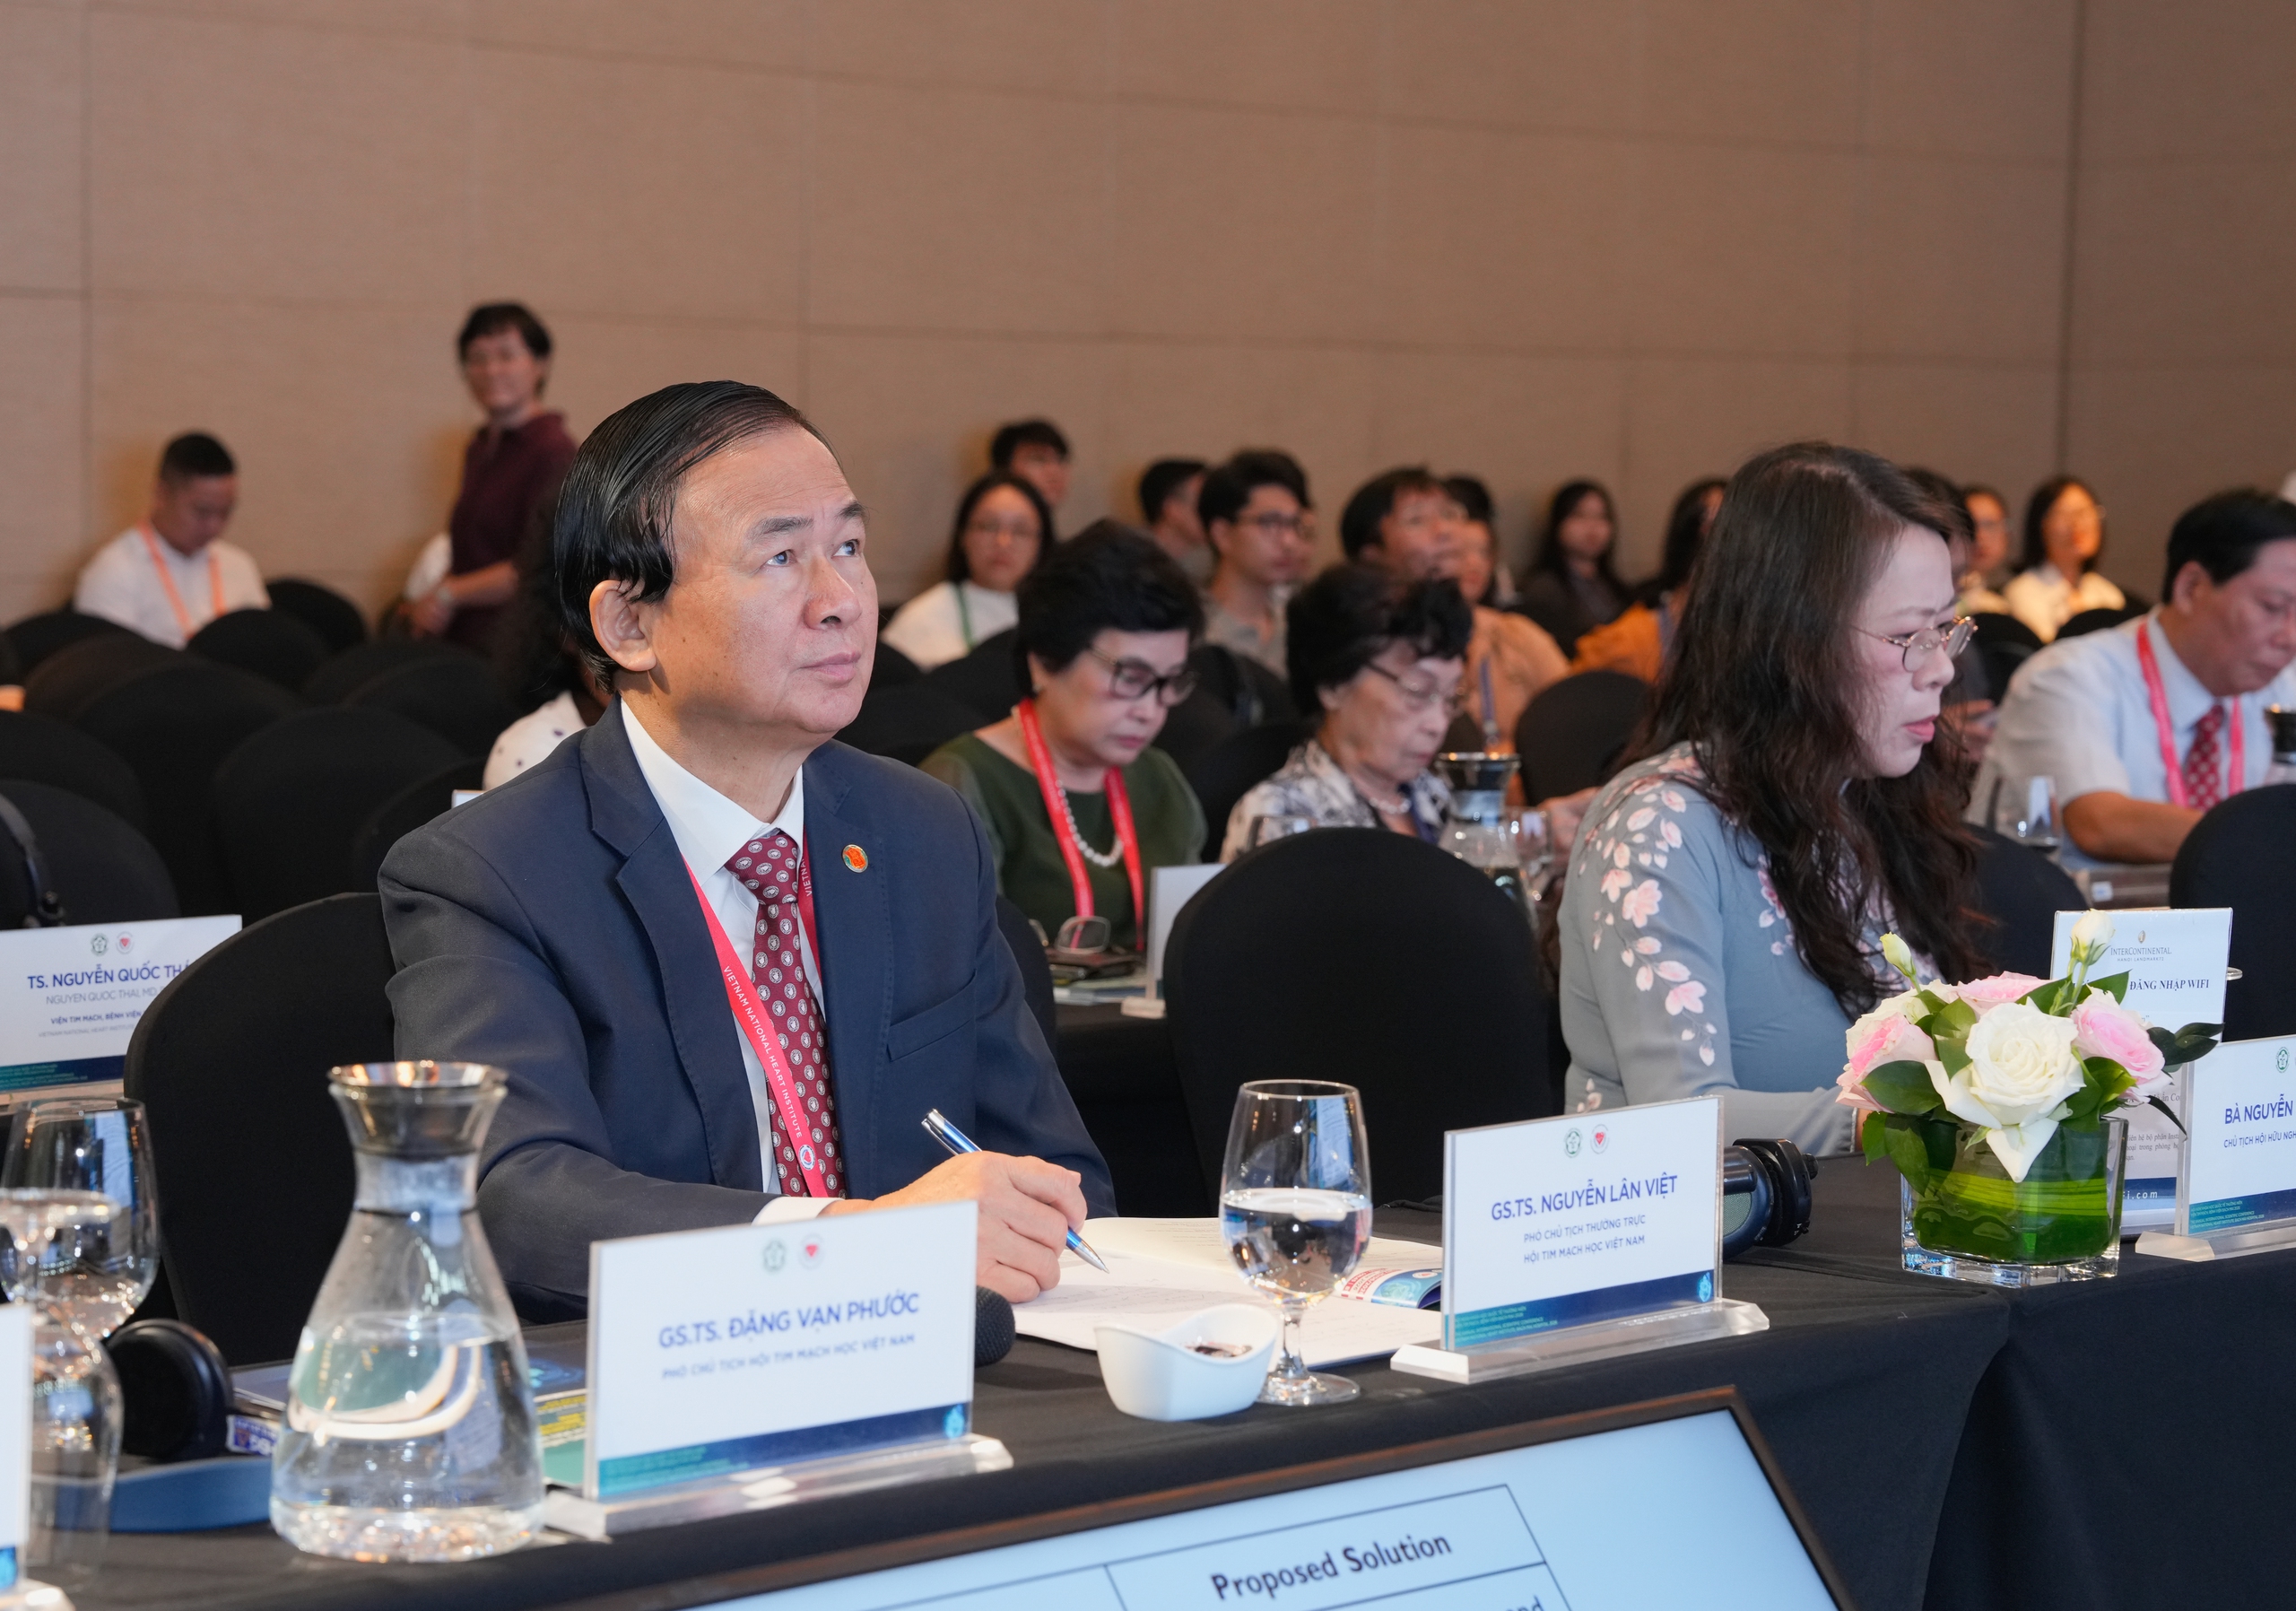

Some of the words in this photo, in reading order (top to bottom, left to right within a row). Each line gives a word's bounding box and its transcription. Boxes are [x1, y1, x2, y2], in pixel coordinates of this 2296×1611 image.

[800, 858, 813, 897] VIETNA
[27, 975, 48, 989] TS.
[52, 963, 114, 988] NGUYỄN
[117, 960, 160, 982] QUỐC
[2129, 979, 2157, 990] ĐĂNG
[2159, 978, 2186, 991] NHẬP
[2187, 979, 2210, 988] WIFI
[69, 1015, 81, 1023] TIM
[723, 965, 750, 1007] VIETNAM
[744, 1006, 772, 1055] NATIONAL
[768, 1055, 787, 1086] HEART
[781, 1088, 803, 1139] INSTITUTE
[2224, 1102, 2241, 1125] BÀ
[2244, 1093, 2293, 1121] NGUYỄN
[2223, 1134, 2238, 1148] CHỦ
[2239, 1136, 2254, 1148] TỊCH
[2255, 1132, 2266, 1145] HỘI
[2267, 1130, 2283, 1143] HỮU
[1491, 1197, 1537, 1221] GS.TS.
[1541, 1178, 1606, 1213] NGUYỄN
[1610, 1177, 1641, 1203] LÂN
[1645, 1171, 1678, 1199] VIỆT
[1524, 1228, 1543, 1243] PHÓ
[1544, 1223, 1563, 1241] CHỦ
[1564, 1223, 1584, 1239] TỊCH
[1623, 1214, 1647, 1230] TRỰC
[1523, 1249, 1540, 1265] HỘI
[1542, 1249, 1557, 1260] TIM
[1558, 1244, 1583, 1259] MẠCH
[1584, 1241, 1604, 1256] HỌC
[1605, 1235, 1624, 1250] VIỆT
[1625, 1234, 1645, 1248] NAM
[658, 1320, 722, 1348] GS.TS.
[728, 1308, 791, 1343] ĐẶNG
[846, 1288, 920, 1322] PHƯỚC
[1209, 1549, 1340, 1601] Proposed
[1342, 1533, 1454, 1574] Solution
